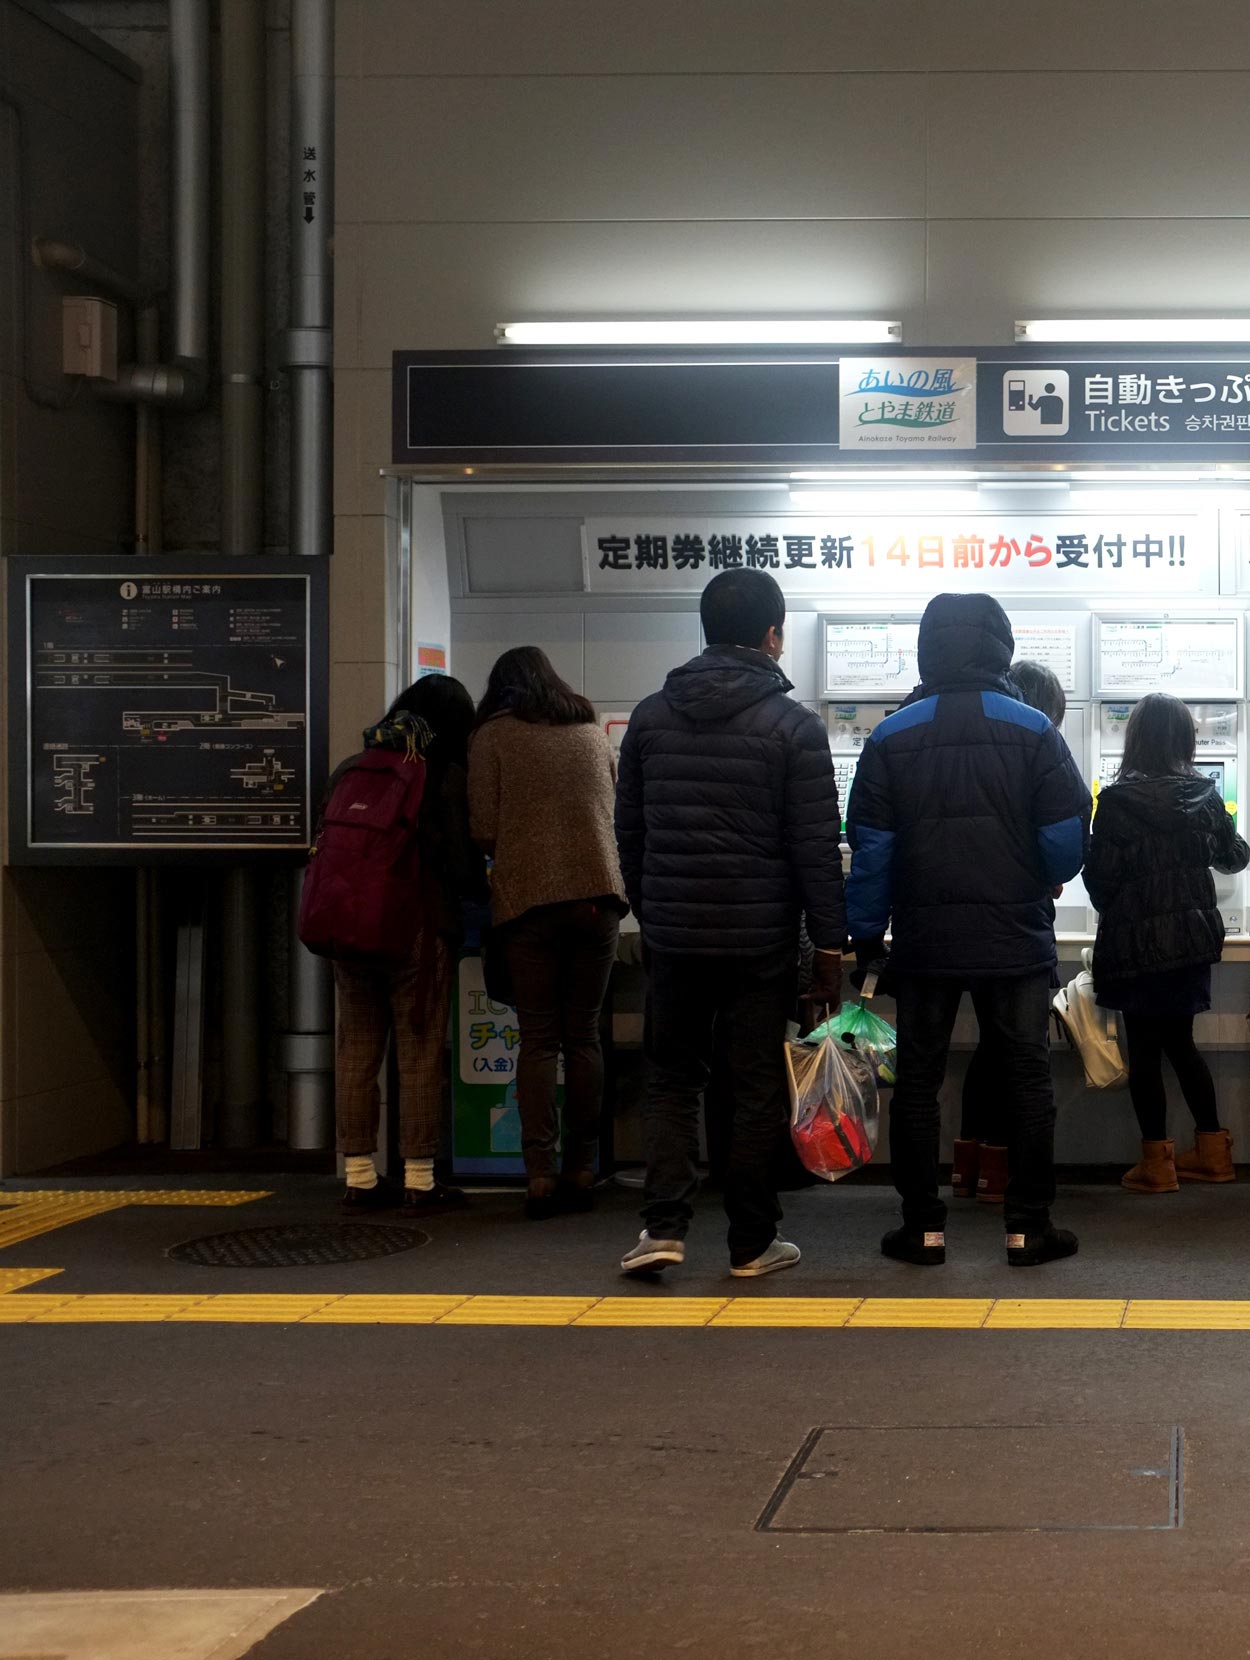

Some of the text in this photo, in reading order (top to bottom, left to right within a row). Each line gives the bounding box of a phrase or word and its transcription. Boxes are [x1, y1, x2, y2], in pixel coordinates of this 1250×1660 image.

[858, 369, 956, 392] あいの風
[858, 400, 956, 423] とやま鉄道
[1085, 409, 1170, 432] Tickets
[896, 435, 925, 443] Toyama
[928, 435, 957, 443] Railway
[853, 726, 872, 735] きっ
[469, 1022, 522, 1050] チャ
